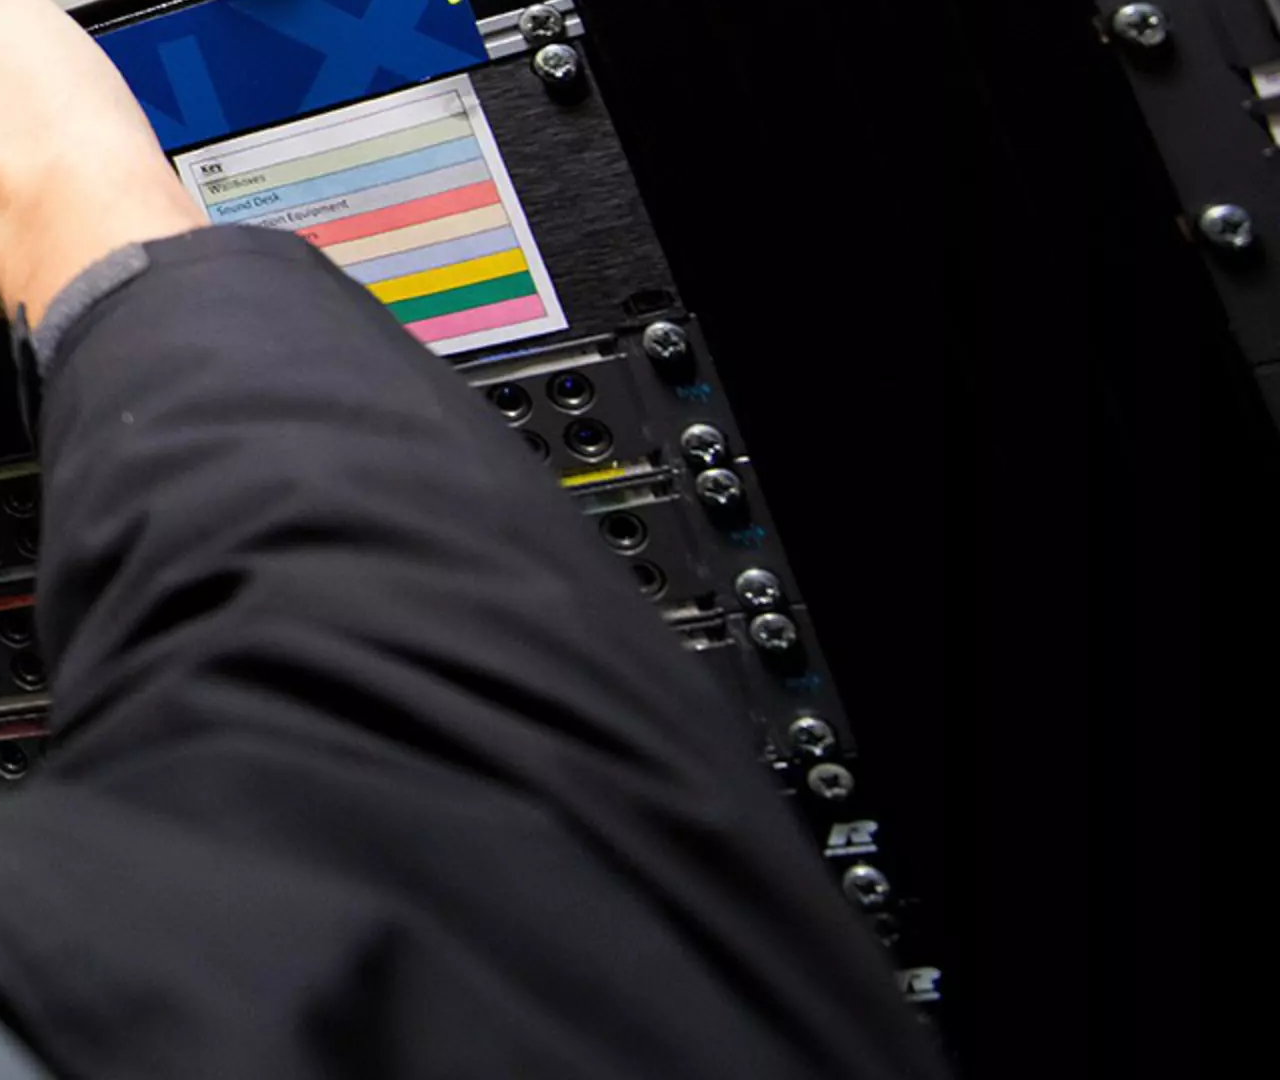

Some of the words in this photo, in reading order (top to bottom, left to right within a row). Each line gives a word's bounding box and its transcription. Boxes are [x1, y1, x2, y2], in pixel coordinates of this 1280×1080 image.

[200, 163, 224, 176] Key
[216, 200, 252, 217] Sound
[253, 191, 281, 208] Desk
[289, 198, 351, 222] Equipment
